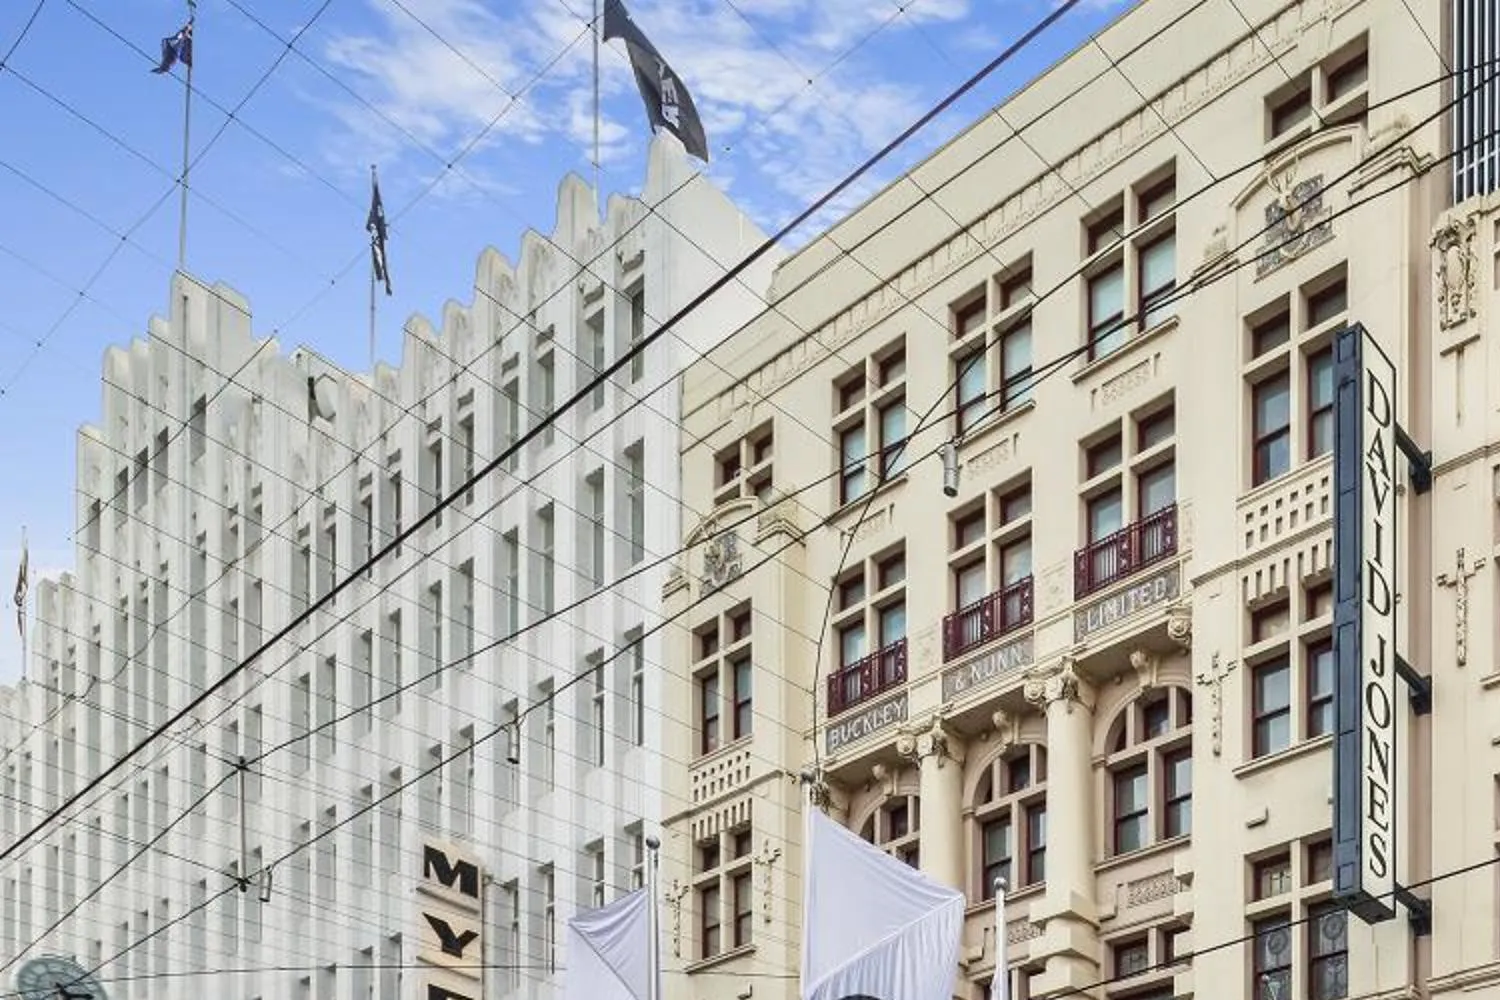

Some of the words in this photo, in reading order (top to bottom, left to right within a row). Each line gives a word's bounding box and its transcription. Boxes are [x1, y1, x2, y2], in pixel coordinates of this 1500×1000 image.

[1366, 367, 1391, 617] DAVID
[1086, 576, 1168, 632] LIMITED
[971, 647, 1023, 682] NUNN
[829, 697, 907, 746] BUCKLEY
[1366, 633, 1391, 879] JONES
